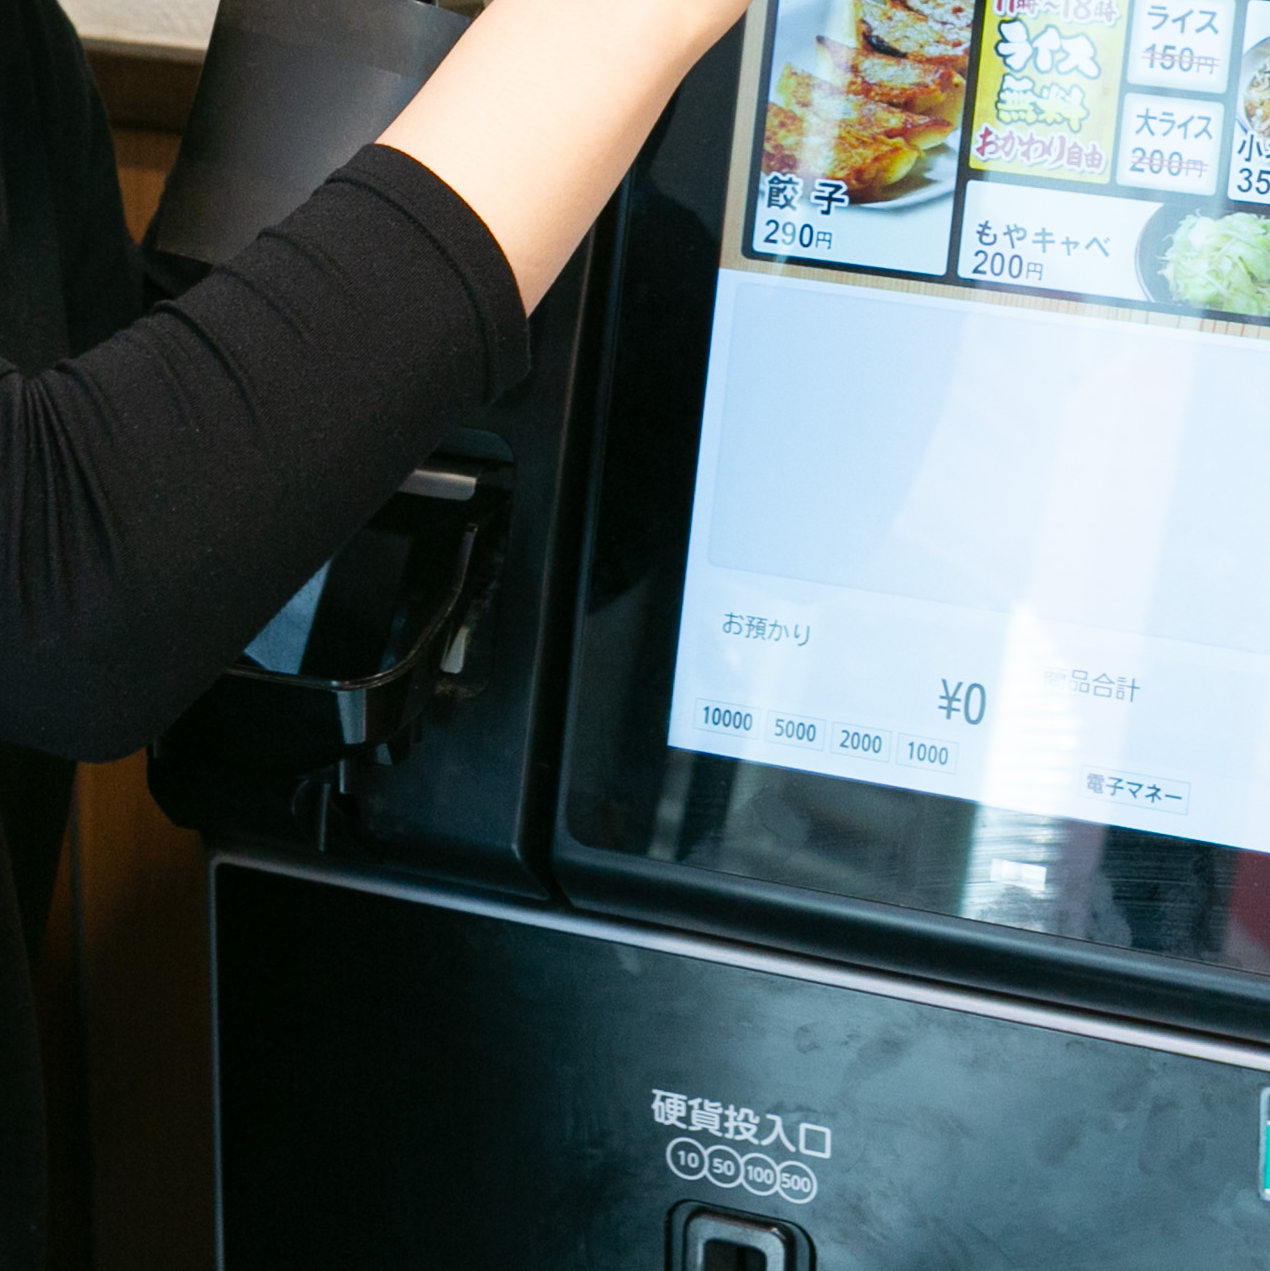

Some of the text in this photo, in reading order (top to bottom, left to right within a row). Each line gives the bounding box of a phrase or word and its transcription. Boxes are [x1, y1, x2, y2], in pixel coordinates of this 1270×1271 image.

[1147, 5, 1219, 35] ライス
[995, 19, 1101, 79] ライス
[1135, 108, 1213, 140] 大ライス
[976, 127, 1106, 172] おかわり自由
[765, 175, 849, 216] 餃子
[764, 219, 833, 251] 290円
[976, 220, 1111, 259] もやキャベ
[972, 250, 1043, 281] 200円
[722, 611, 811, 646] お預かり
[702, 705, 949, 767] 10000 5000 2000 1000
[1087, 773, 1182, 803] 電子マネー
[651, 1088, 831, 1159] 硬貨投入口
[677, 1150, 811, 1193] 10 50 100 500
